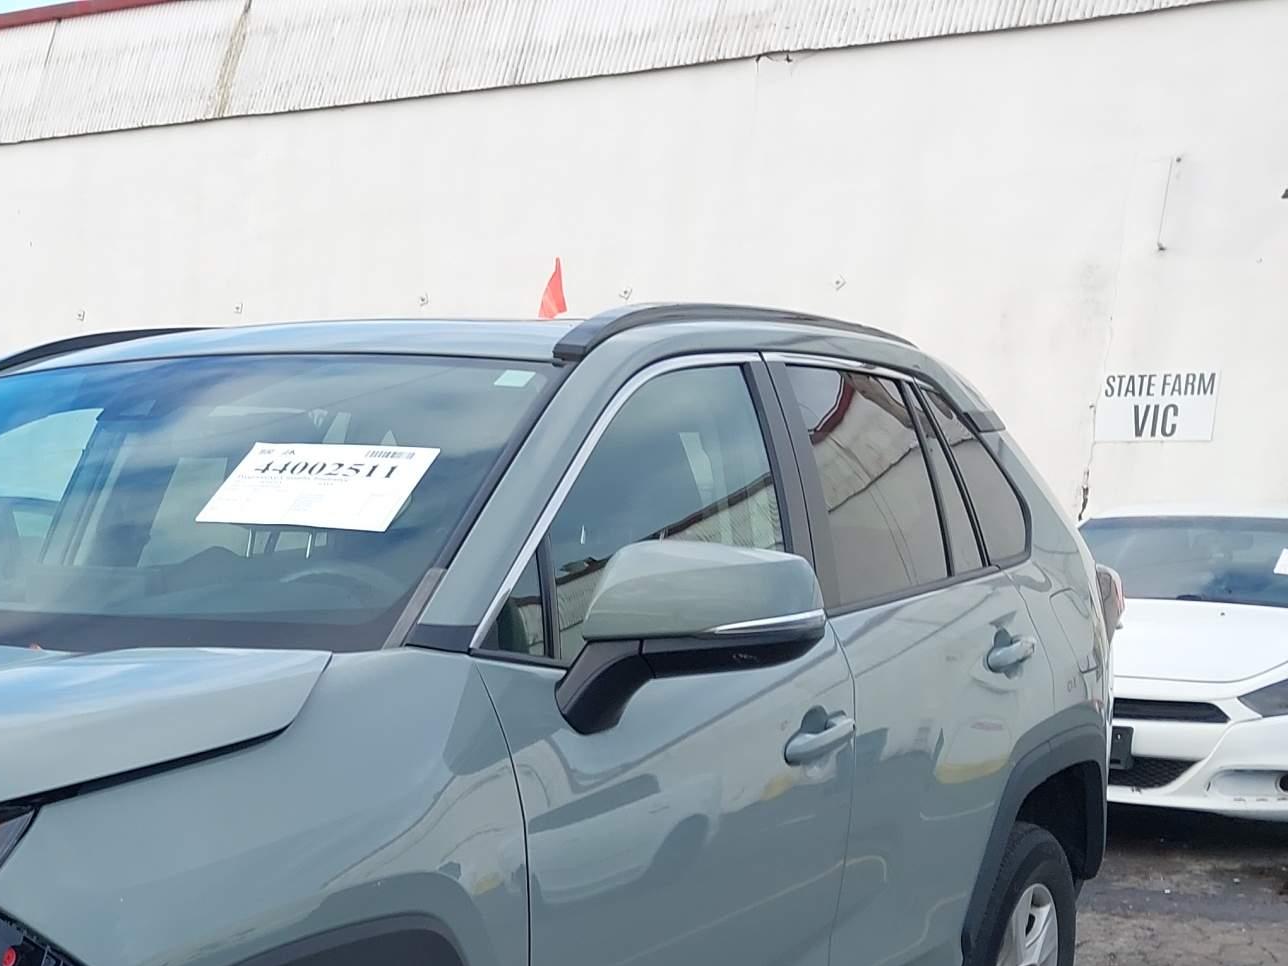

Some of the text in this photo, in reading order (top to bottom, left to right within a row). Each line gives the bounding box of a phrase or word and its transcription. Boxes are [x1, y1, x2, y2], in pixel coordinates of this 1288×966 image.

[1104, 372, 1216, 398] STATE FARM
[1133, 403, 1179, 438] VIC
[254, 460, 398, 479] 44002511
